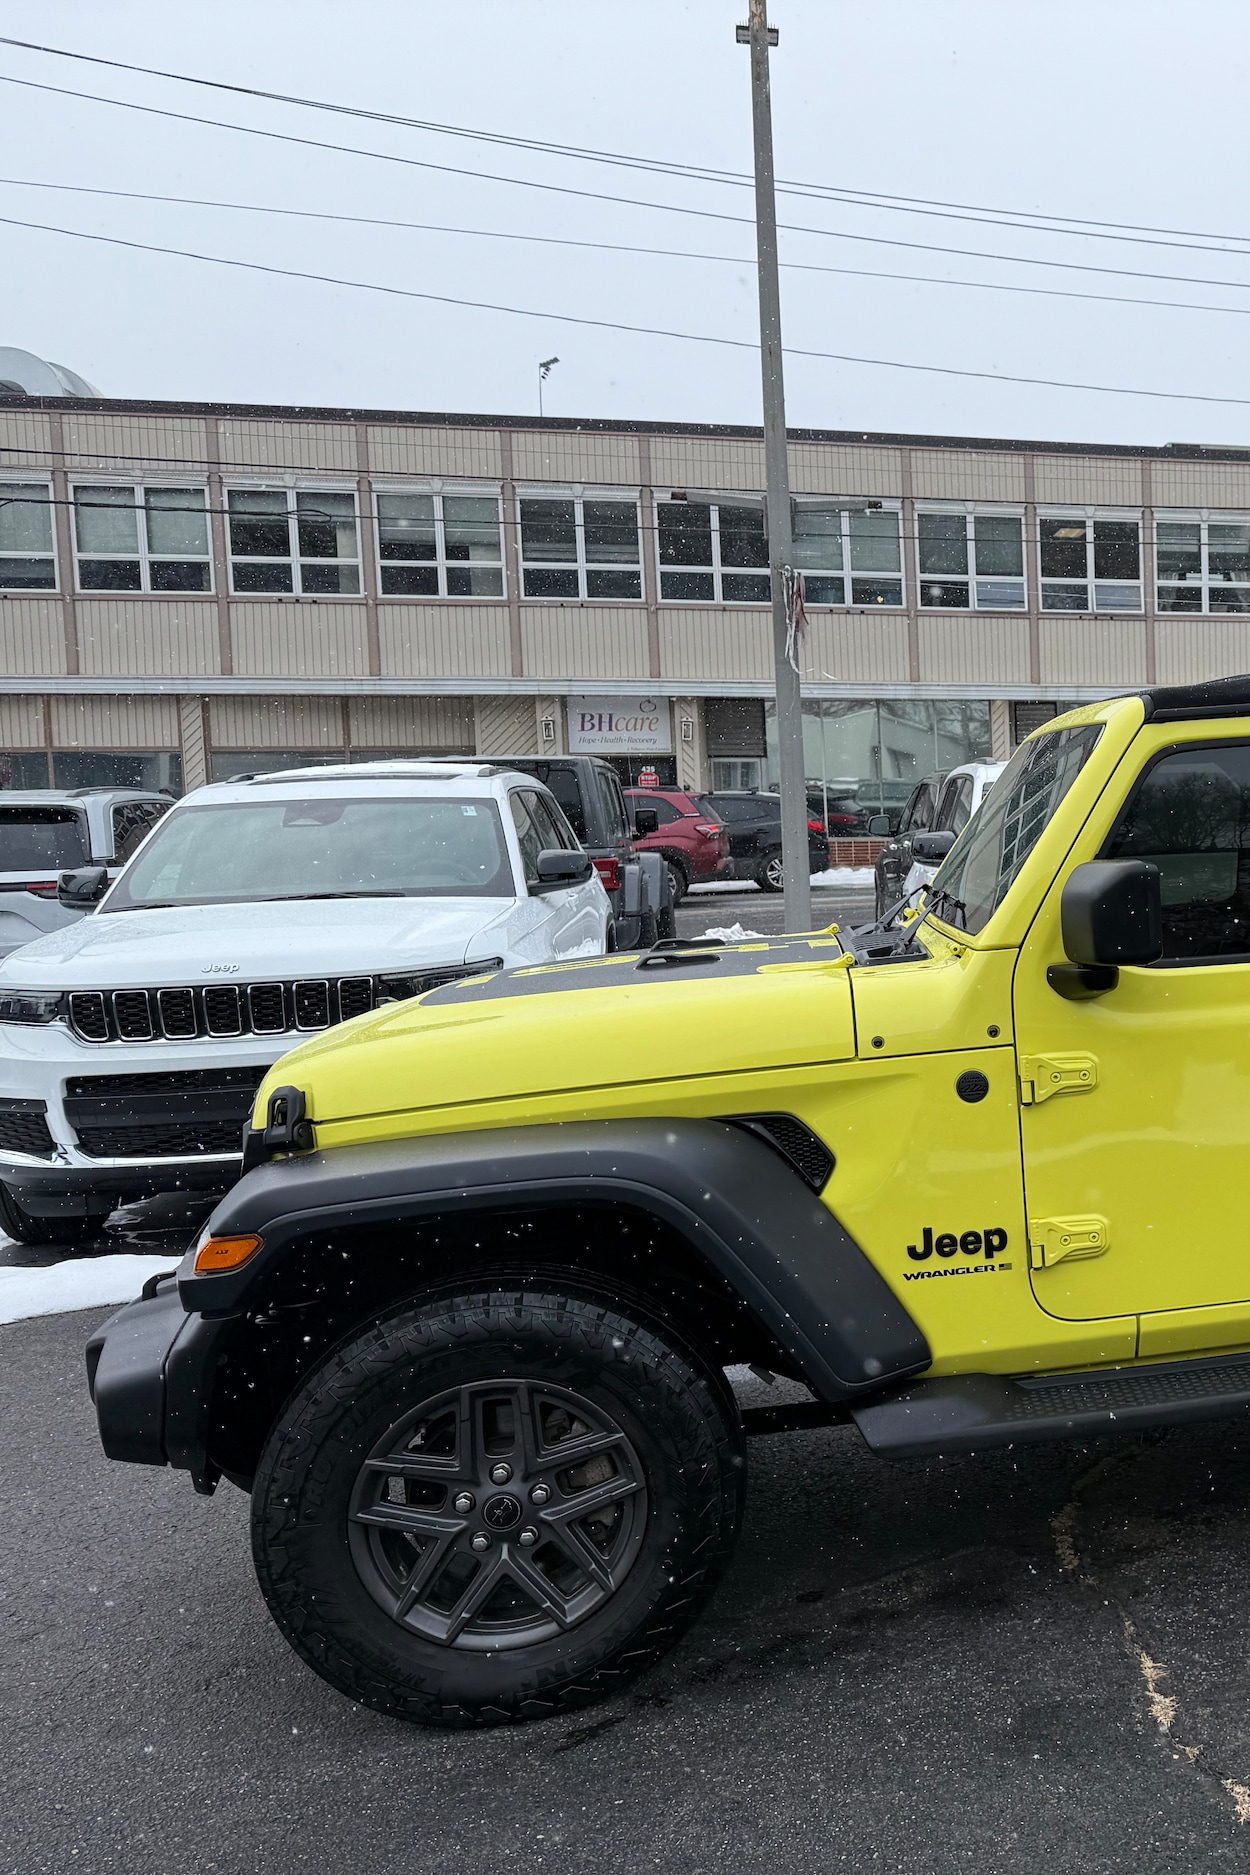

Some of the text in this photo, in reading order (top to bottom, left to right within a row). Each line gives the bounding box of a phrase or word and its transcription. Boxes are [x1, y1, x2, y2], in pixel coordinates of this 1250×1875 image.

[577, 712, 660, 732] BHcare
[201, 963, 239, 973] Jeep
[907, 1226, 1008, 1260] Jeep
[903, 1264, 996, 1281] WRANGLER
